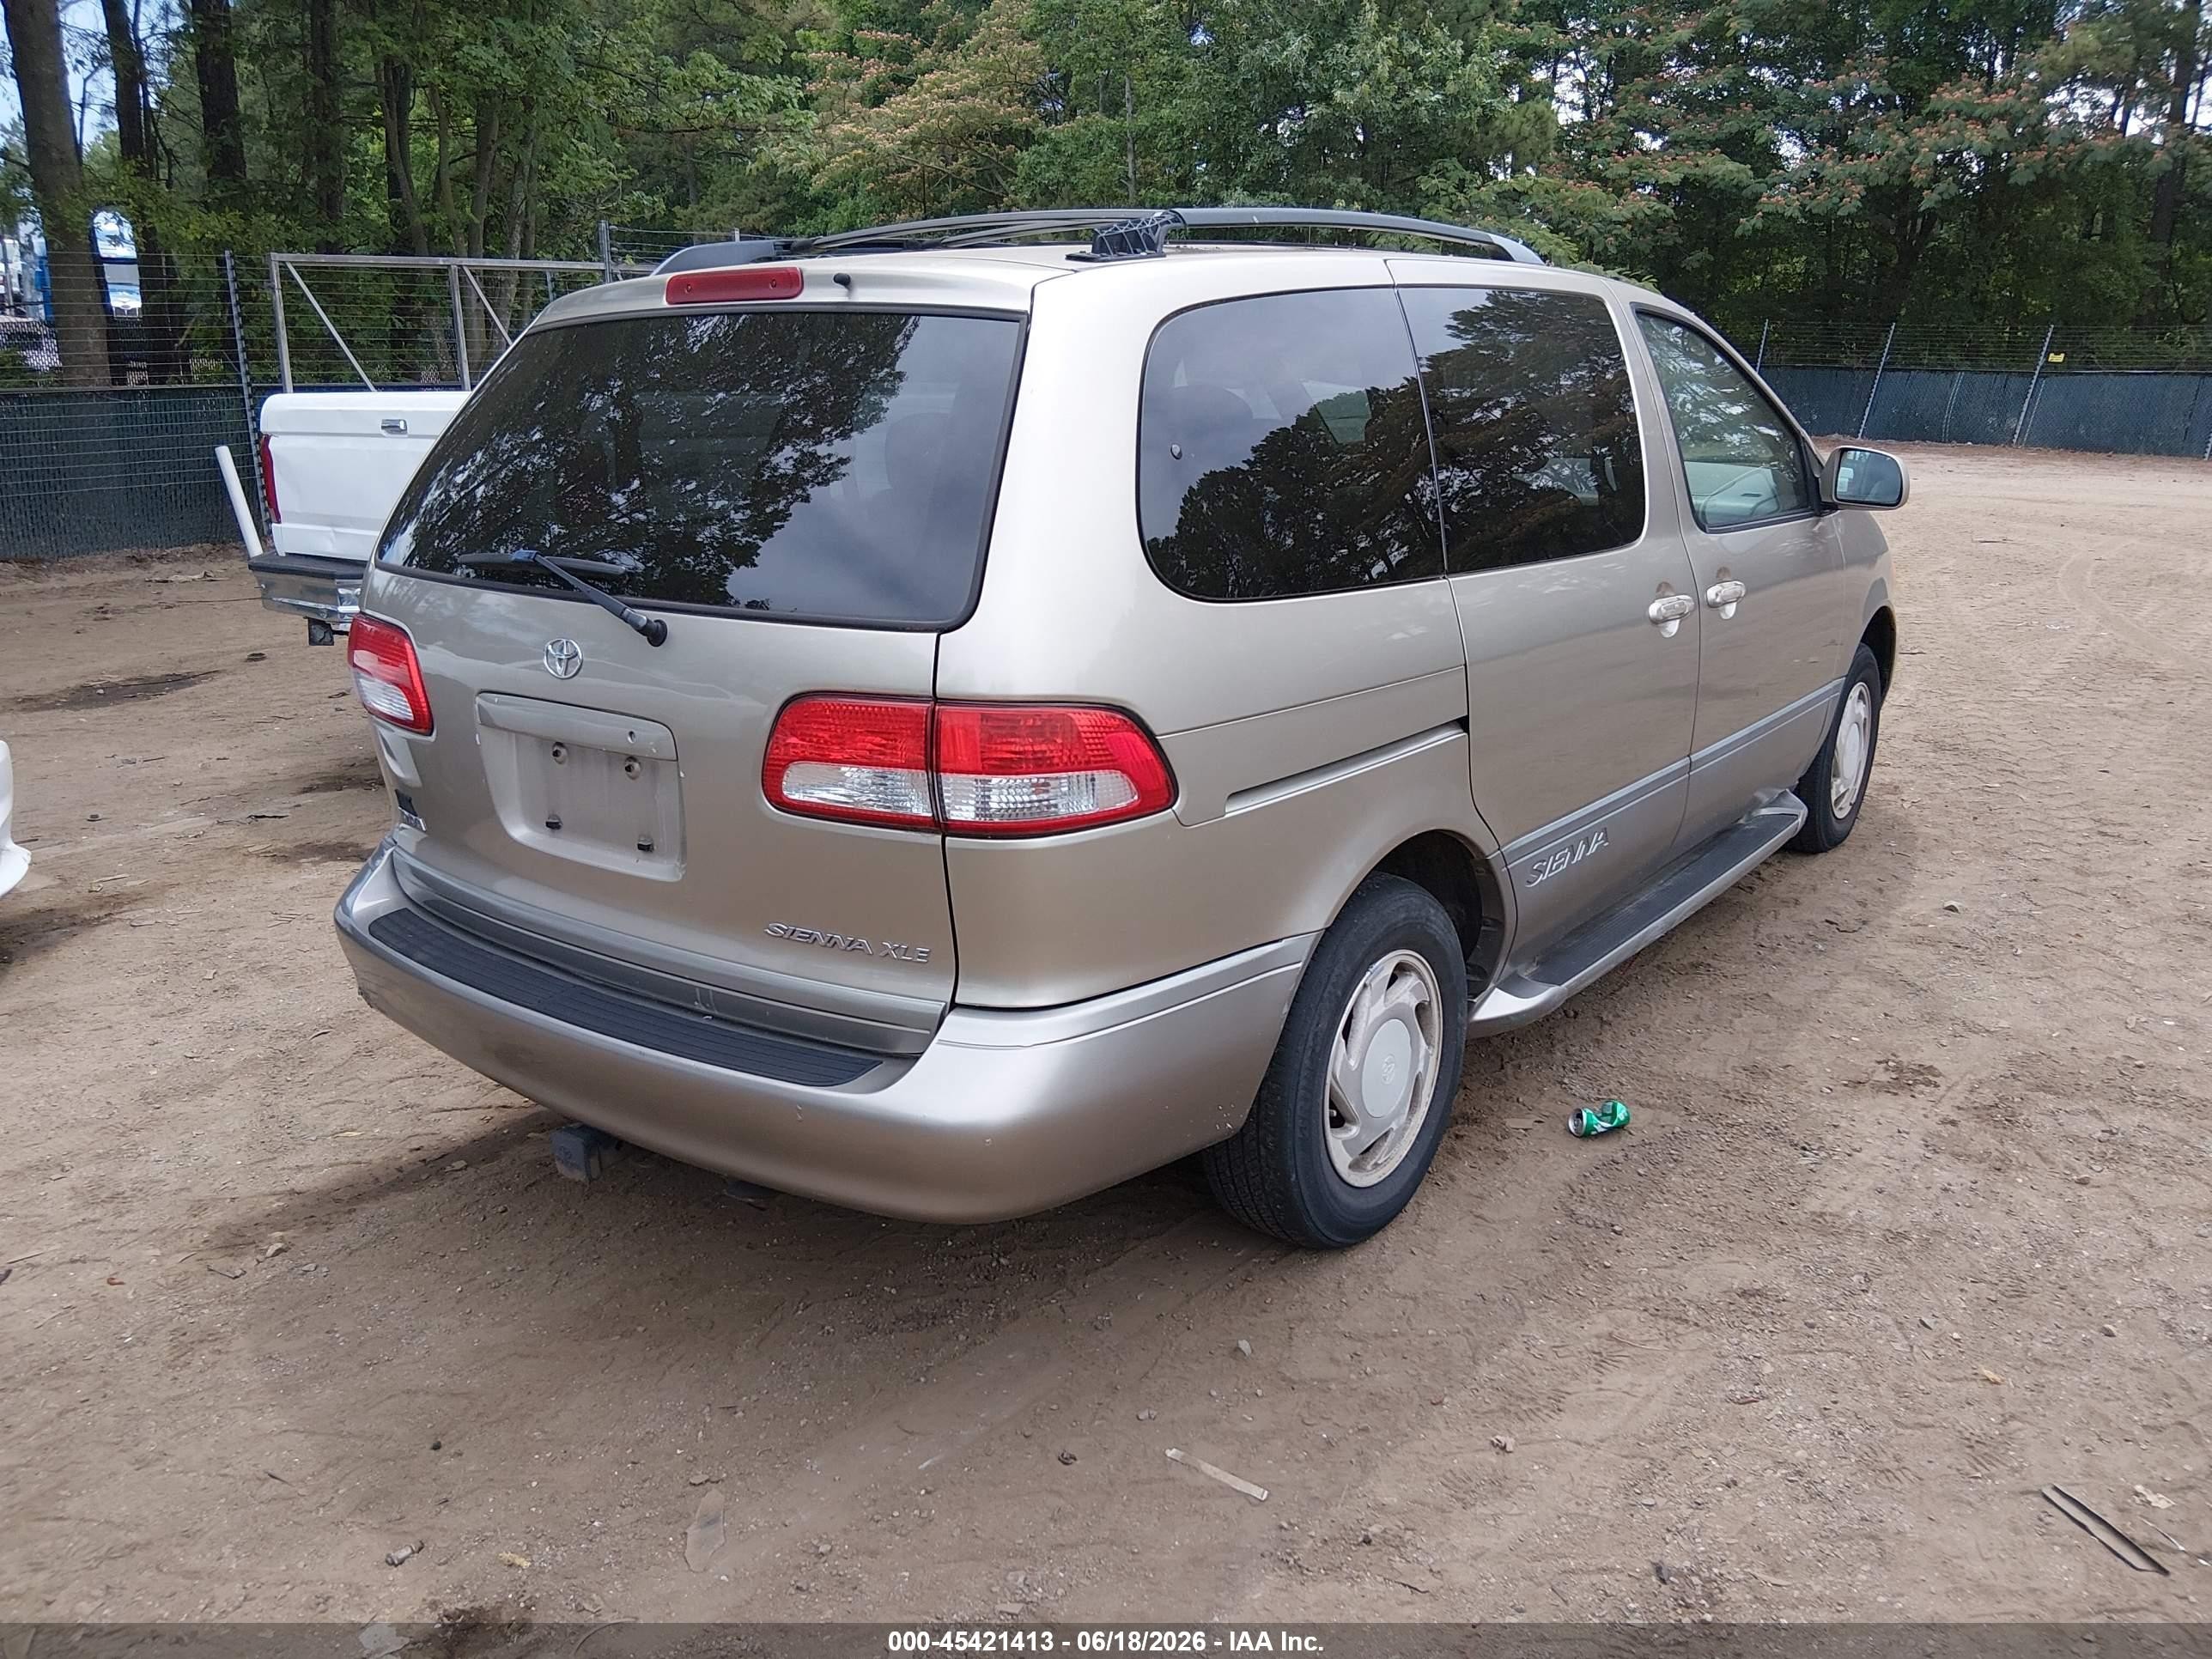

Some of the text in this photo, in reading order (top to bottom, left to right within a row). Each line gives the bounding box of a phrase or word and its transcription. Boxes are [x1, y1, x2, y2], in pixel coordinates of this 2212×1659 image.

[1525, 827, 1609, 888] SIENNA
[764, 921, 931, 963] SIENNA XLE
